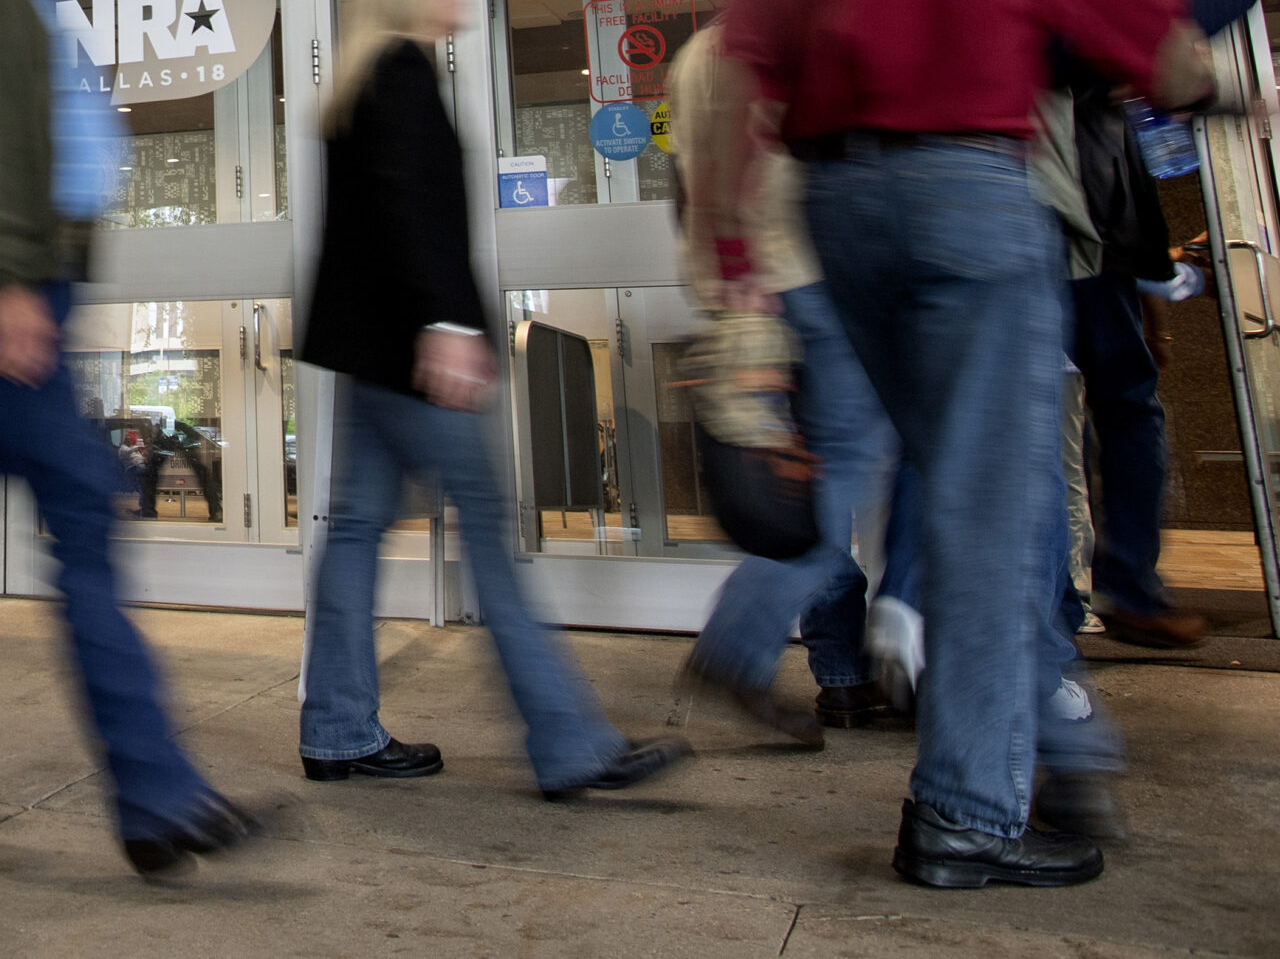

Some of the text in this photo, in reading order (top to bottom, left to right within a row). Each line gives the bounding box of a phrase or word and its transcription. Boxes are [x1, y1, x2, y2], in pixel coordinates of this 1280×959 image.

[590, 3, 614, 15] THIS
[635, 1, 644, 10] A
[599, 11, 679, 27] FREE FACILITY
[79, 64, 225, 93] ALLAS 18
[595, 136, 647, 147] ACTIVATE SWITCH
[604, 144, 639, 154] TO OPERATE
